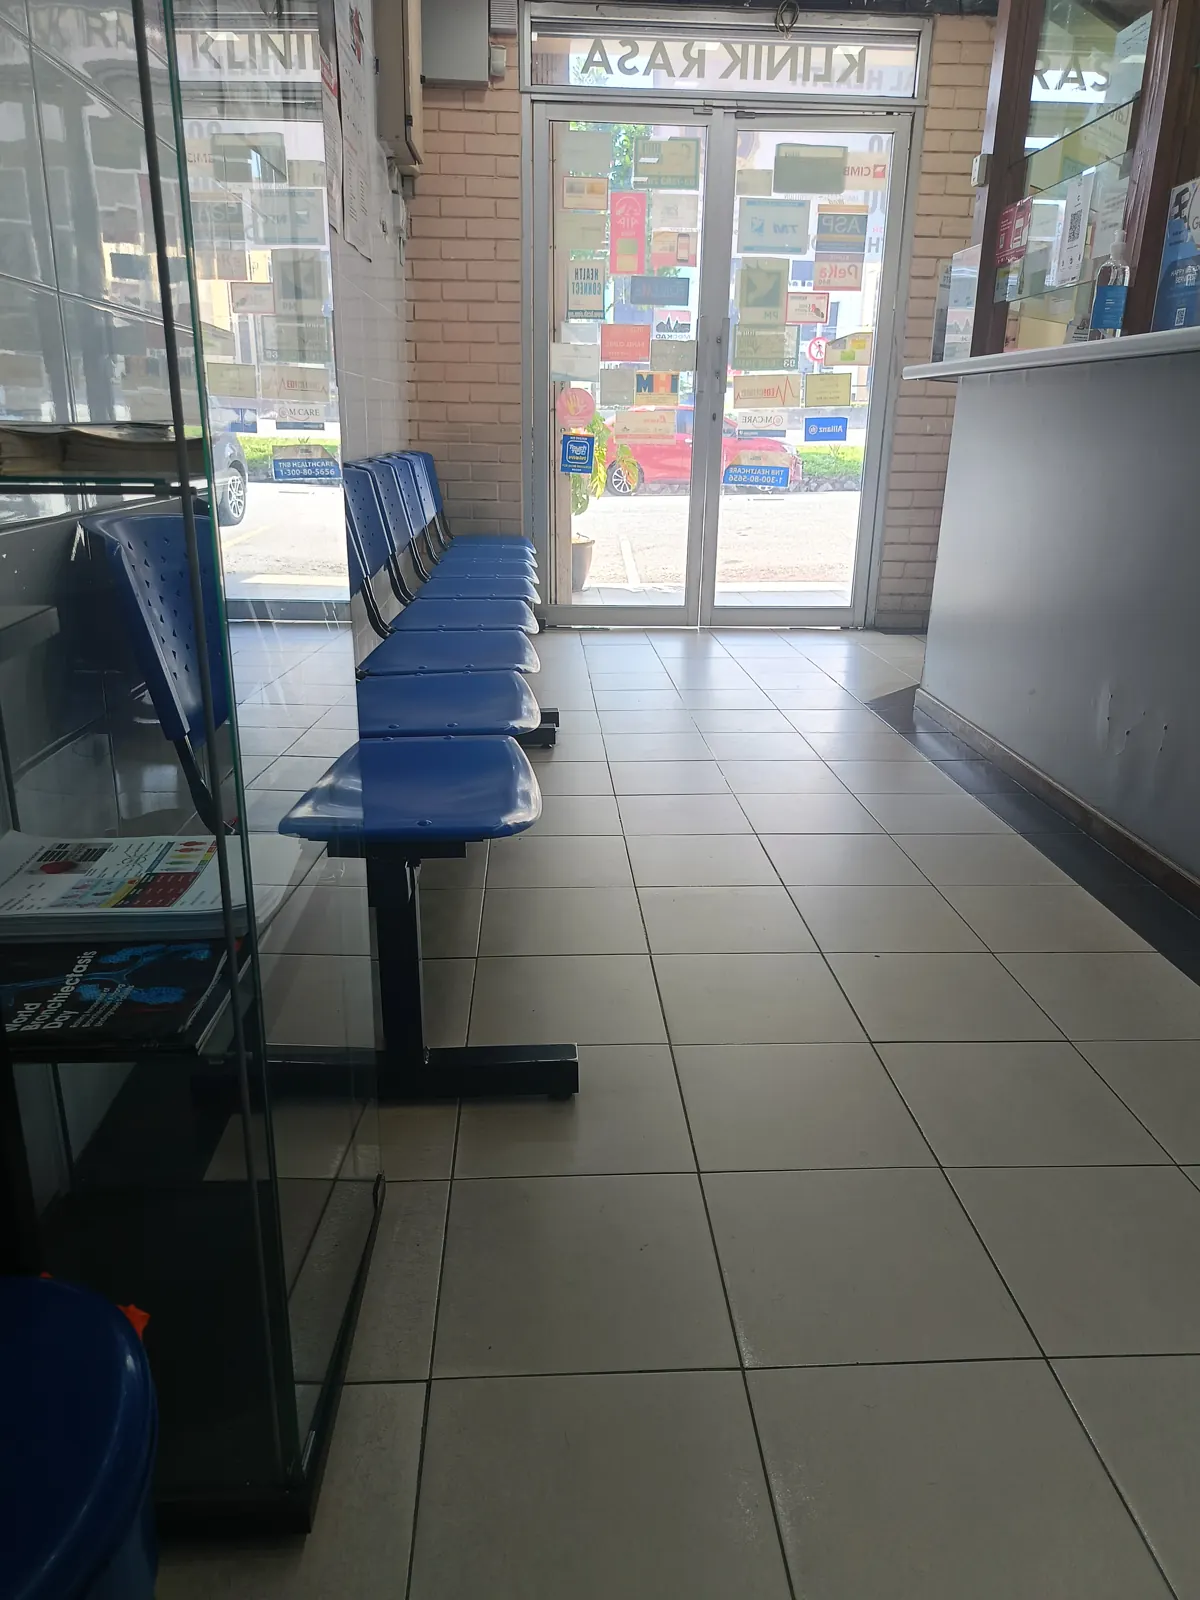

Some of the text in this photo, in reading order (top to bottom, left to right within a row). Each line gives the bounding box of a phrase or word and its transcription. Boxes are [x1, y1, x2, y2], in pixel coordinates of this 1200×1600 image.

[191, 32, 320, 69] KLINI
[279, 468, 336, 476] 1-300-80-5656
[19, 950, 98, 1032] Bronchiectasis
[5, 1002, 42, 1033] World
[42, 1010, 79, 1030] Day
